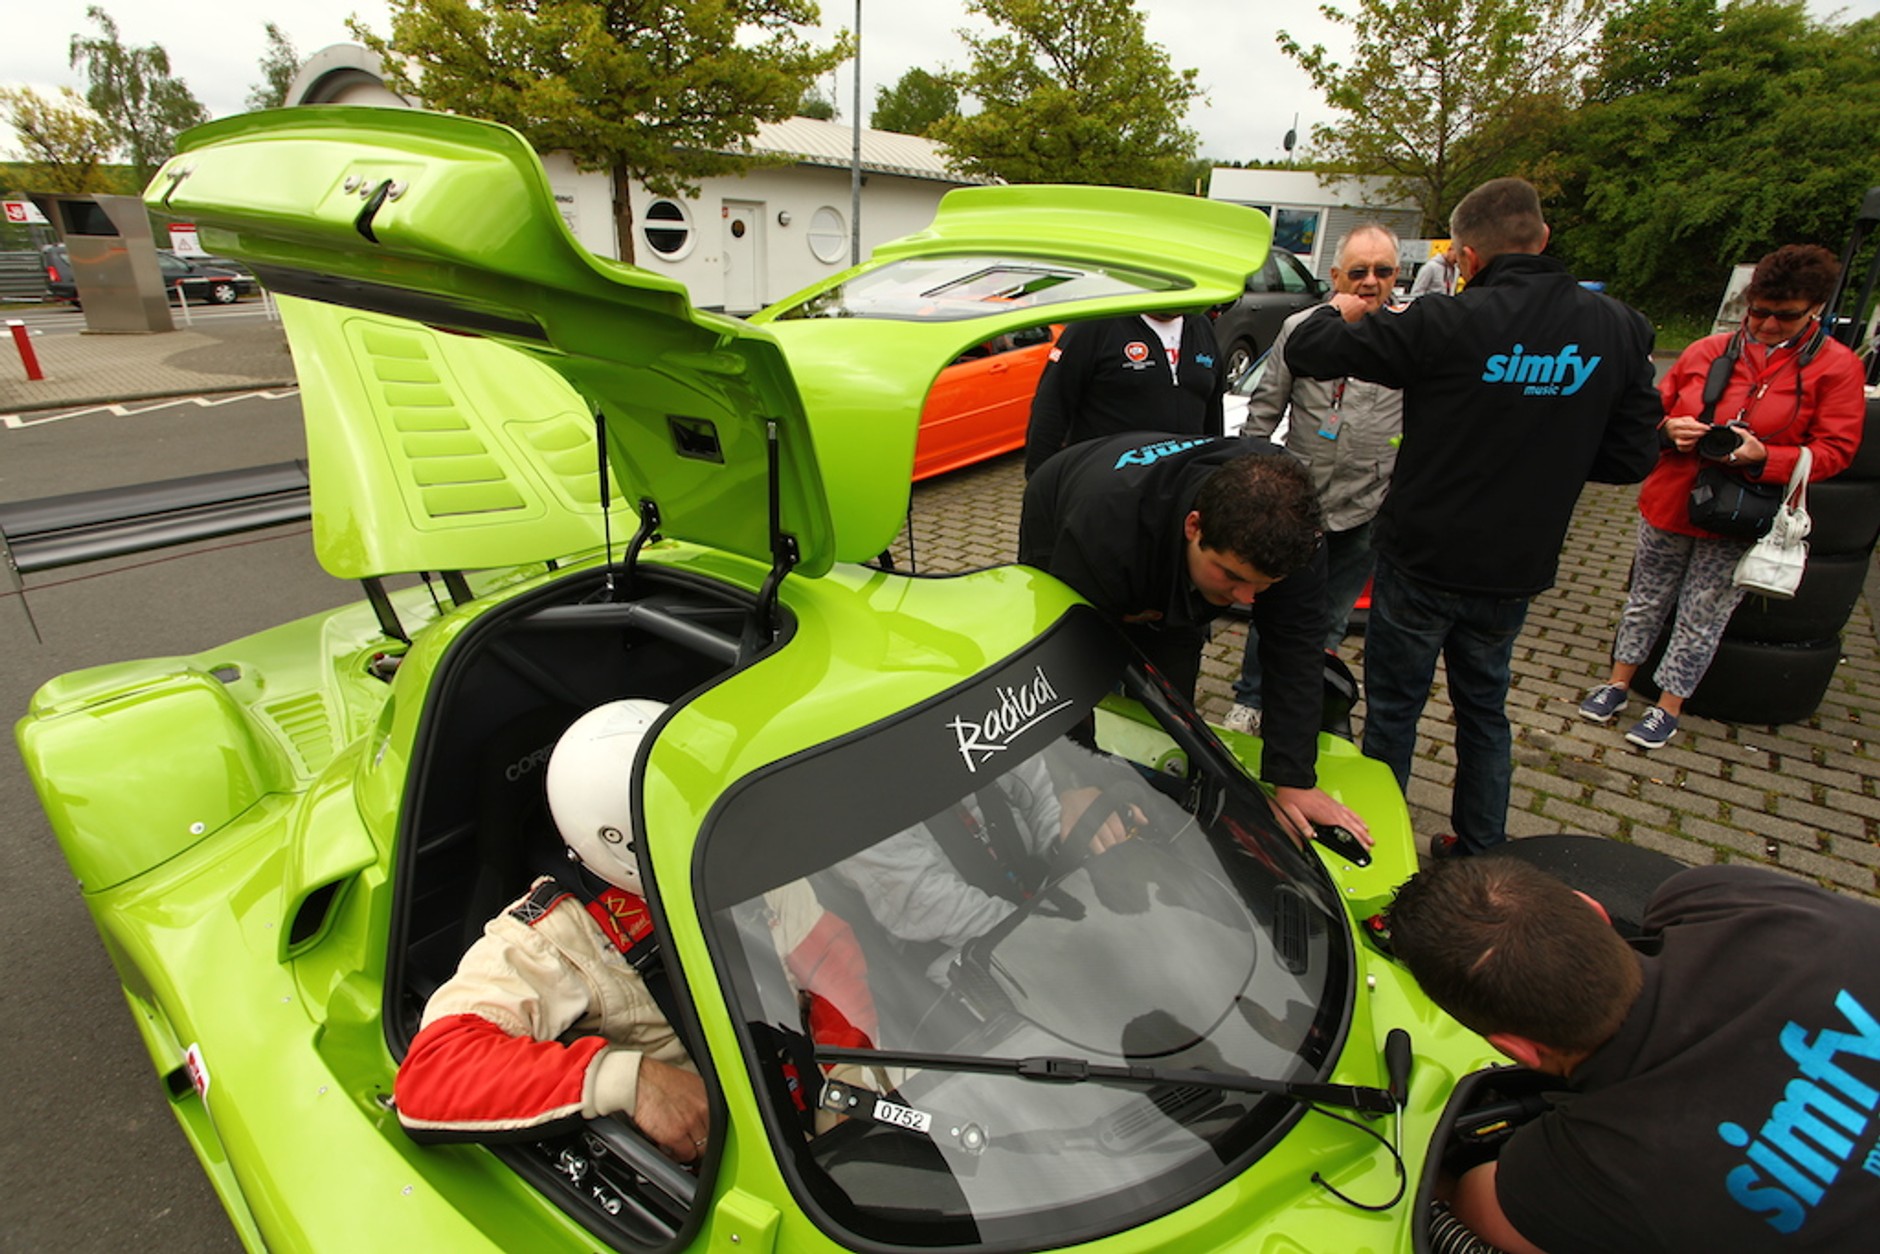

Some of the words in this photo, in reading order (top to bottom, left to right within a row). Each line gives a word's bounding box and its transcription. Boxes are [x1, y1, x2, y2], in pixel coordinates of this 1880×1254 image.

[1481, 343, 1602, 396] simfy
[1524, 383, 1560, 396] music
[945, 665, 1058, 773] Radical
[880, 1103, 926, 1130] 0752
